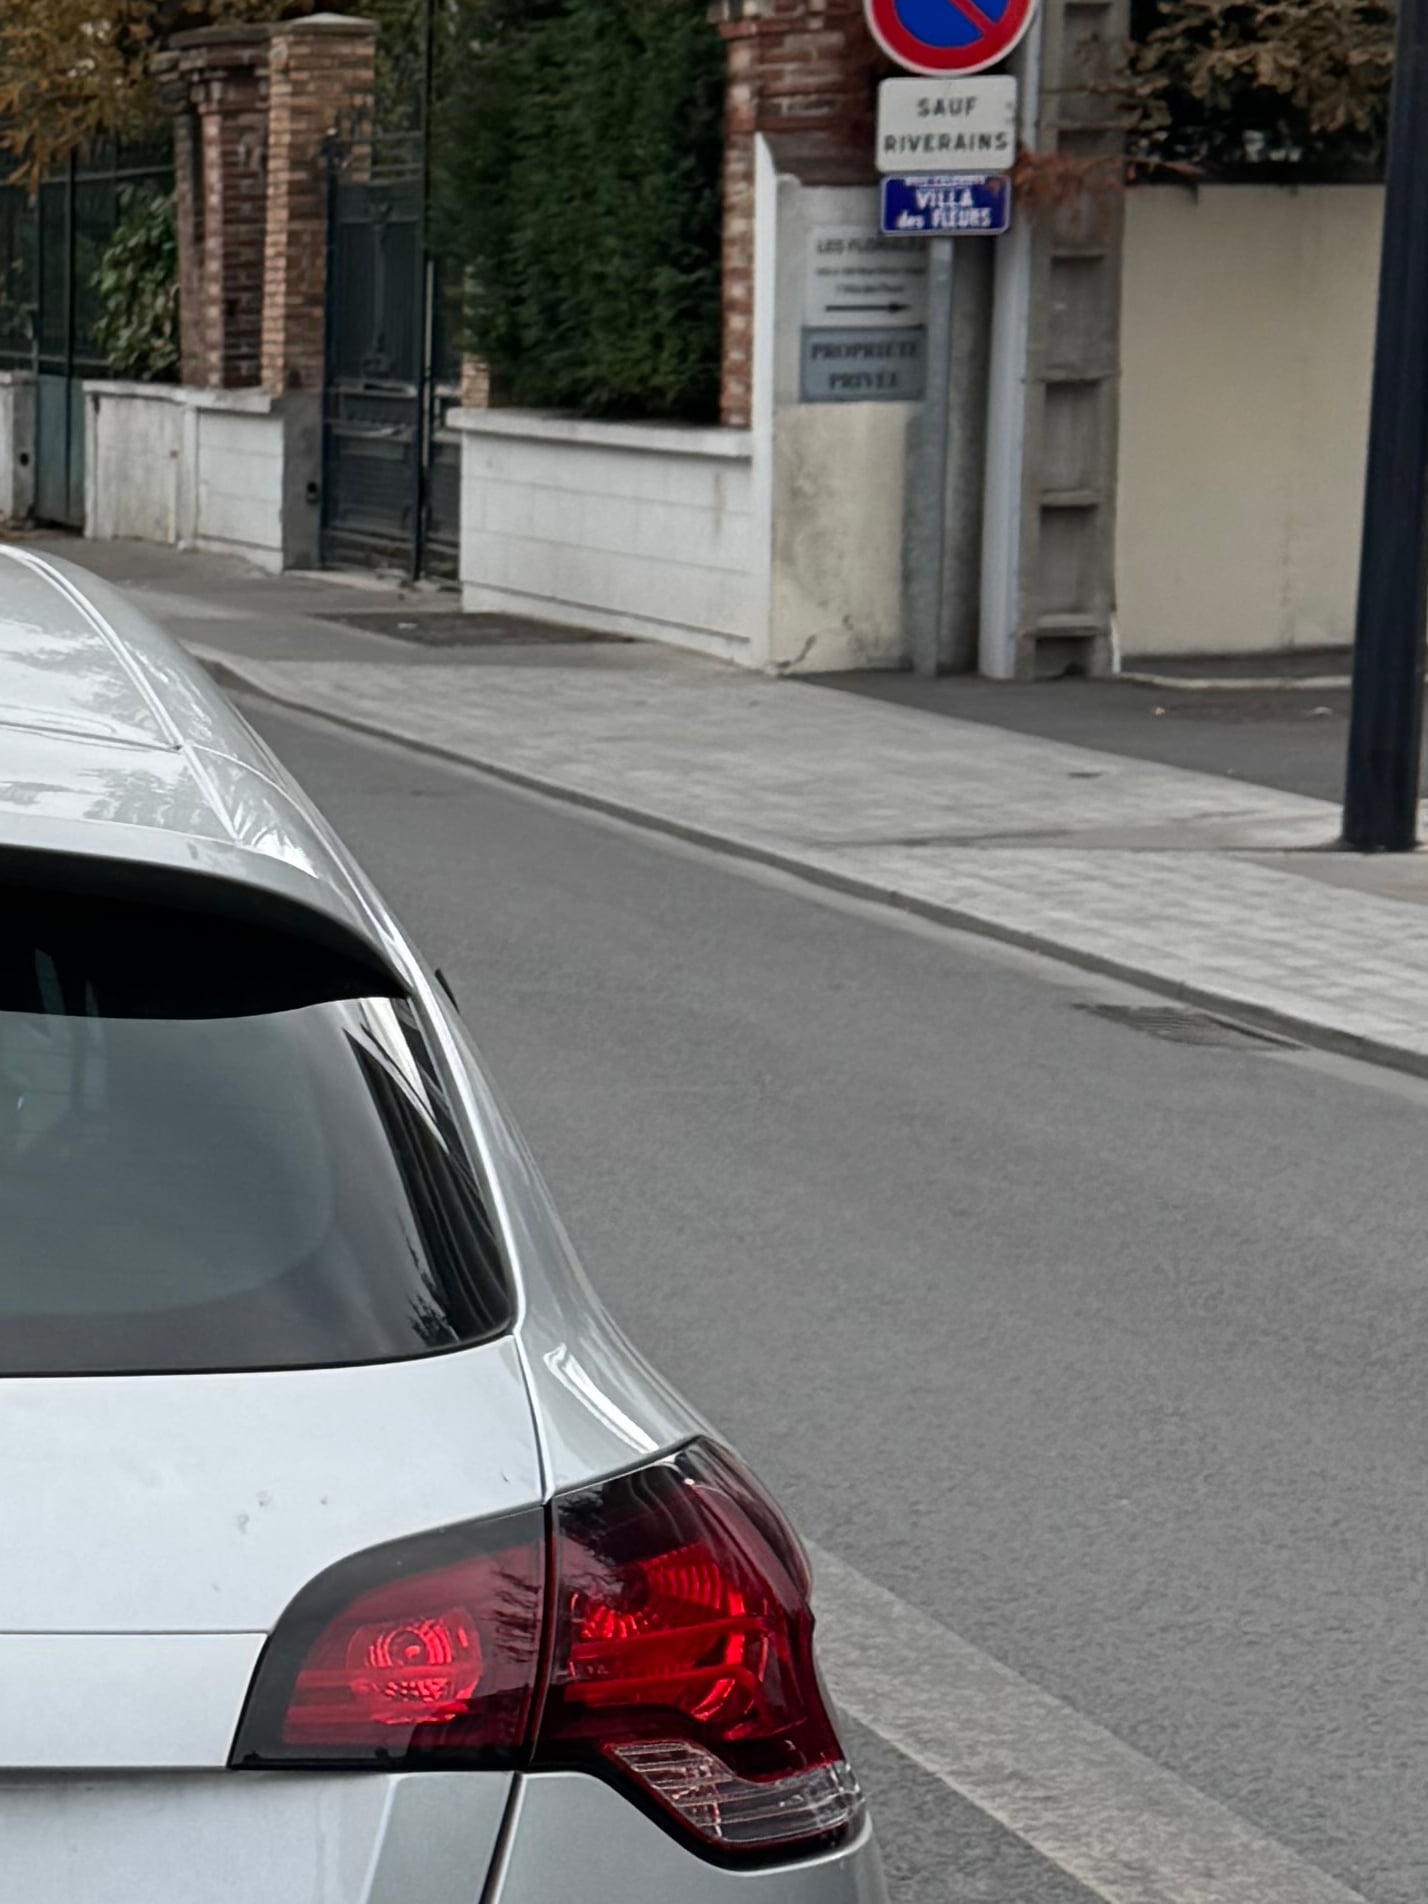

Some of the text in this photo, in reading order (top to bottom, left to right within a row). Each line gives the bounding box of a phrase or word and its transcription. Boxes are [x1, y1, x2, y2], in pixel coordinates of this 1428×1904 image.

[917, 97, 977, 117] SAUF
[884, 132, 1009, 152] RIVERAINS
[915, 188, 974, 209] VILLA
[897, 207, 992, 229] des FLEURS
